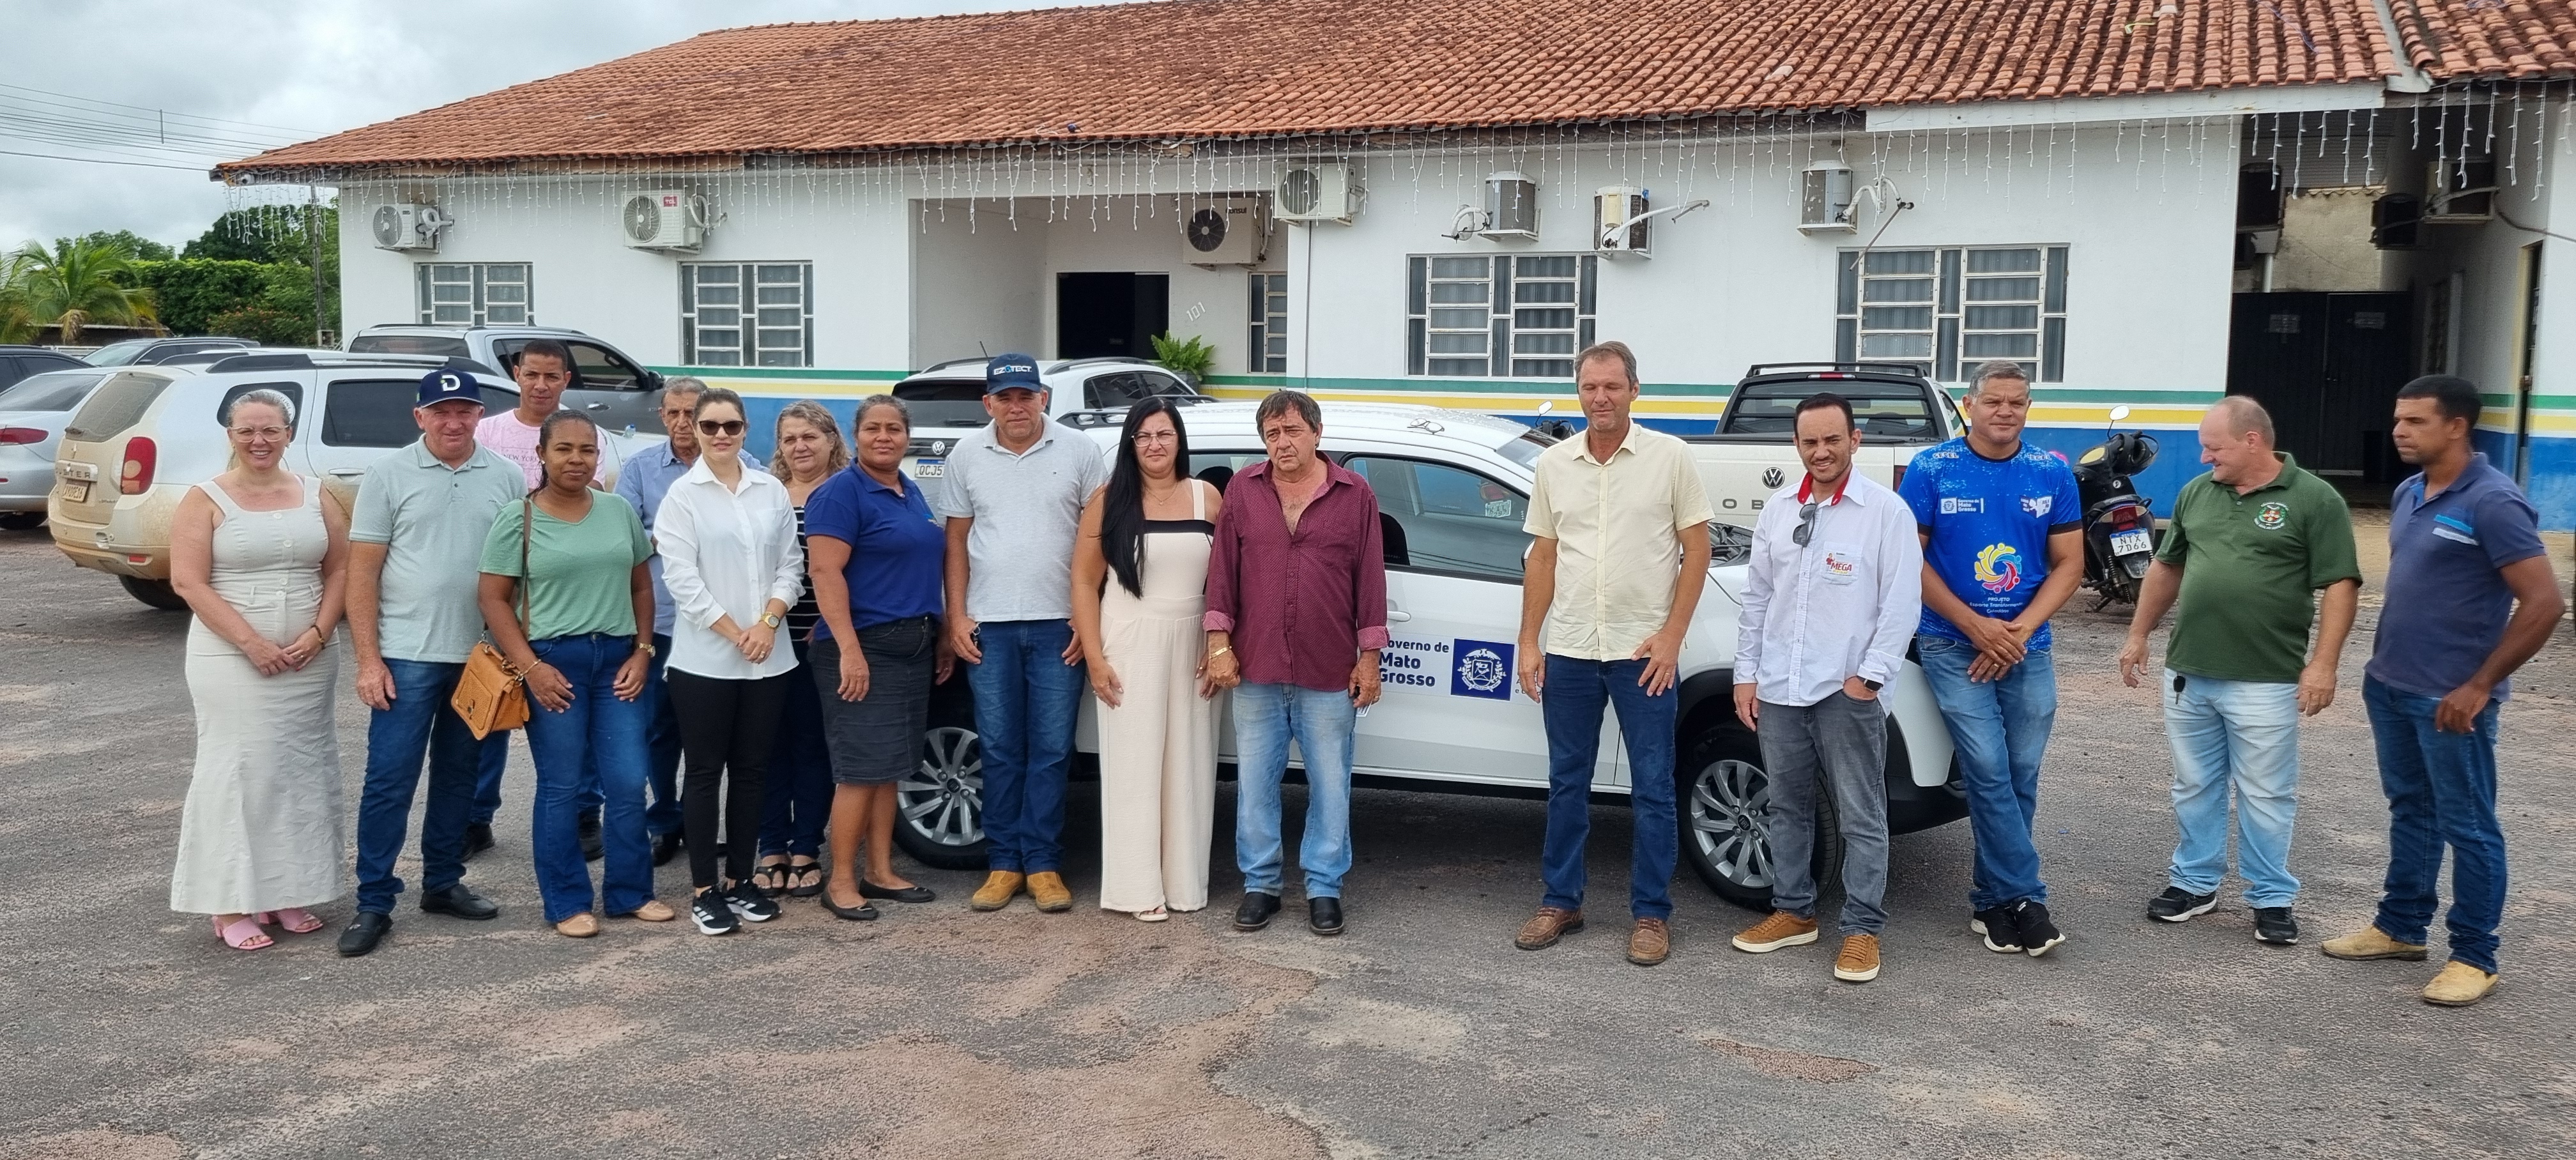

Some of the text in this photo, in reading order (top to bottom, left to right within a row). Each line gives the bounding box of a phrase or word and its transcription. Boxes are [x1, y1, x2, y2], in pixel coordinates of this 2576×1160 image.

[1186, 301, 1206, 321] 101
[2120, 535, 2141, 544] NTX
[2118, 542, 2147, 553] 7D66
[1830, 563, 1852, 572] MEGA
[1388, 640, 1450, 653] overno de
[1379, 652, 1421, 669] Mato
[1379, 668, 1436, 687] Grosso
